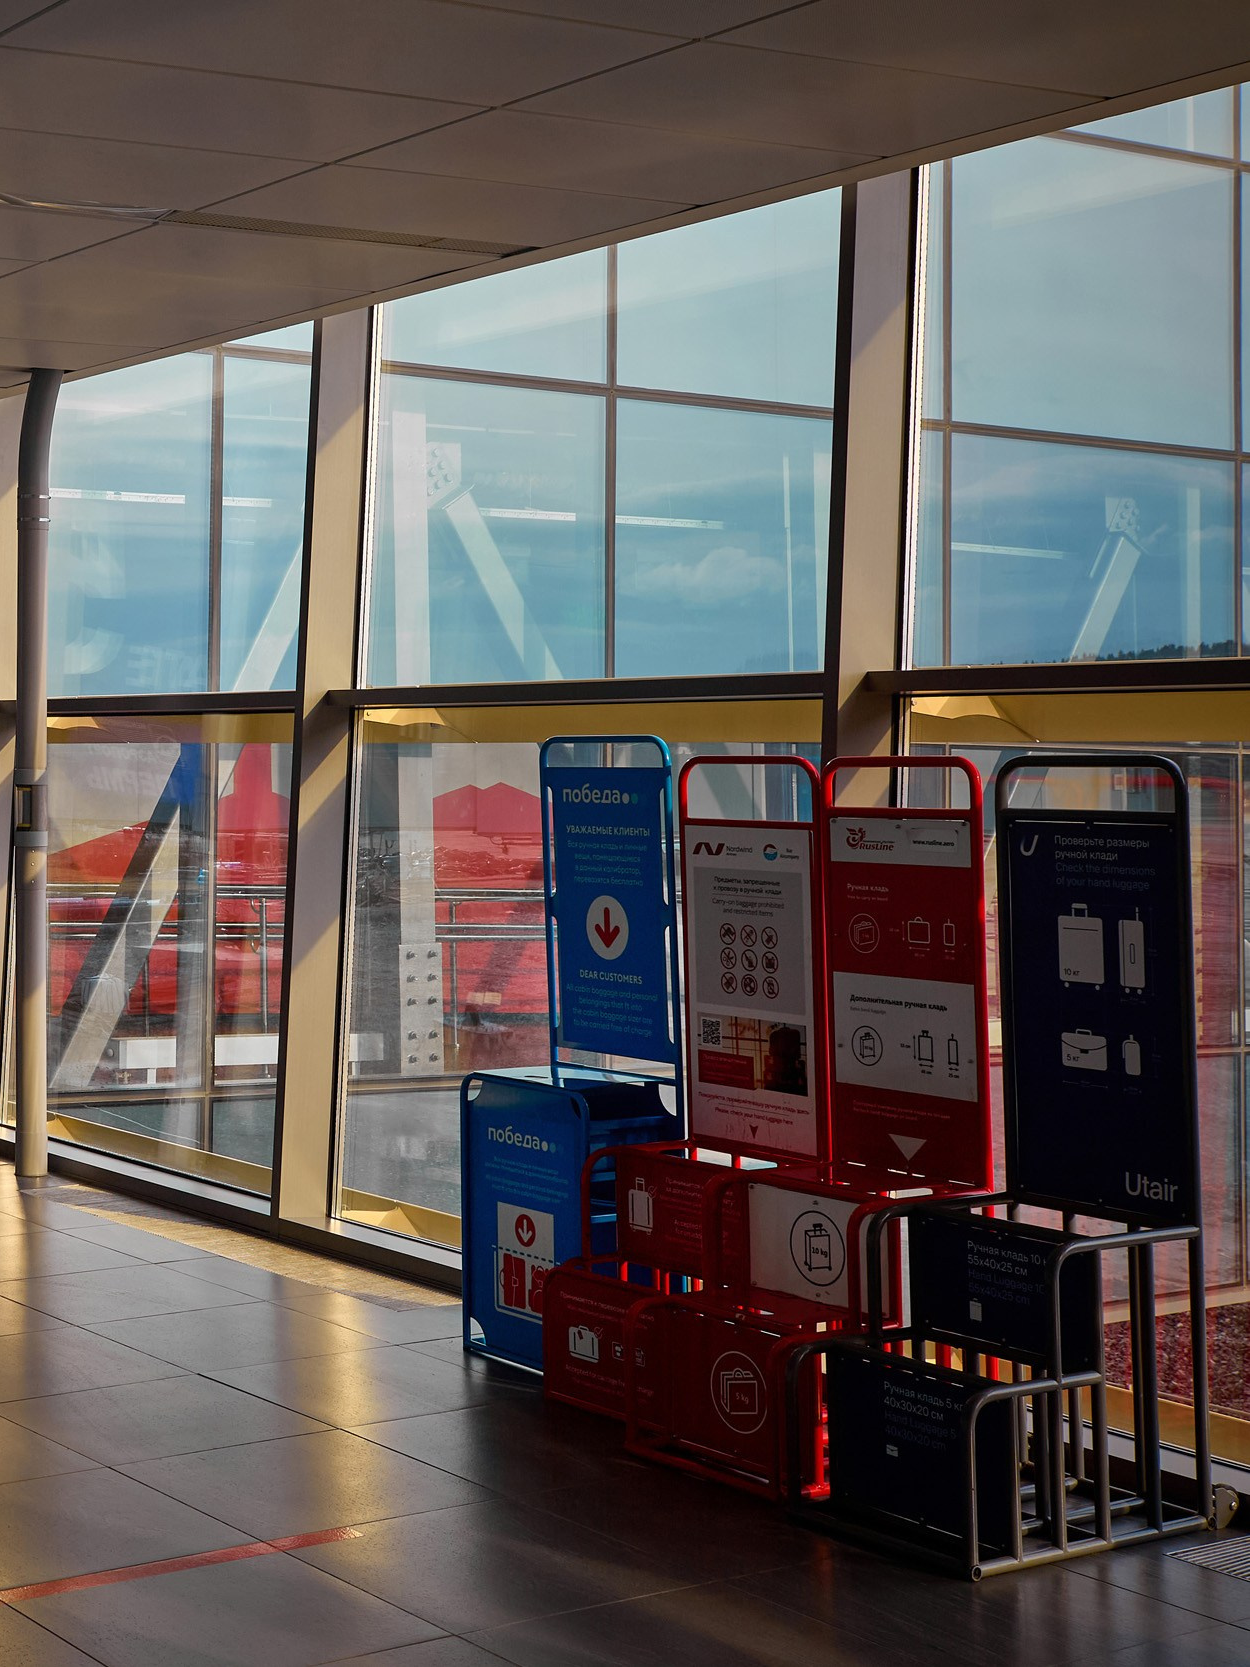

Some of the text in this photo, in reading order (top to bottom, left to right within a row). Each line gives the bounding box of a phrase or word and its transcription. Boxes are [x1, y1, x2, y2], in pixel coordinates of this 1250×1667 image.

[562, 783, 621, 804] победа
[566, 825, 650, 837] УВАЖАЕМЫЕ КЛИЕНТЫ
[1054, 835, 1150, 849] Проверьте размеры
[726, 846, 753, 854] Nordwind
[1055, 850, 1119, 861] ручной клади
[1055, 862, 1156, 877] Check the dimensions
[1056, 875, 1150, 891] of your hand luggage
[579, 969, 643, 985] DEAR CUSTOMERS
[1064, 968, 1072, 976] 10
[850, 994, 948, 1012] Дополнительная ручная кладь
[1066, 1054, 1072, 1062] 5
[488, 1126, 540, 1150] победа
[1125, 1171, 1179, 1202] Utair
[820, 1248, 828, 1258] kg
[967, 1240, 999, 1255] Ручная
[1001, 1249, 1029, 1263] кладь
[1030, 1254, 1041, 1265] 10
[1014, 1266, 1028, 1276] см
[968, 1268, 992, 1282] Hand
[994, 1272, 1033, 1292] Luggage
[735, 1392, 749, 1405] 5 kg
[884, 1381, 915, 1398] Ручная
[917, 1392, 944, 1406] кладь
[946, 1398, 952, 1409] 5
[931, 1411, 944, 1421] см
